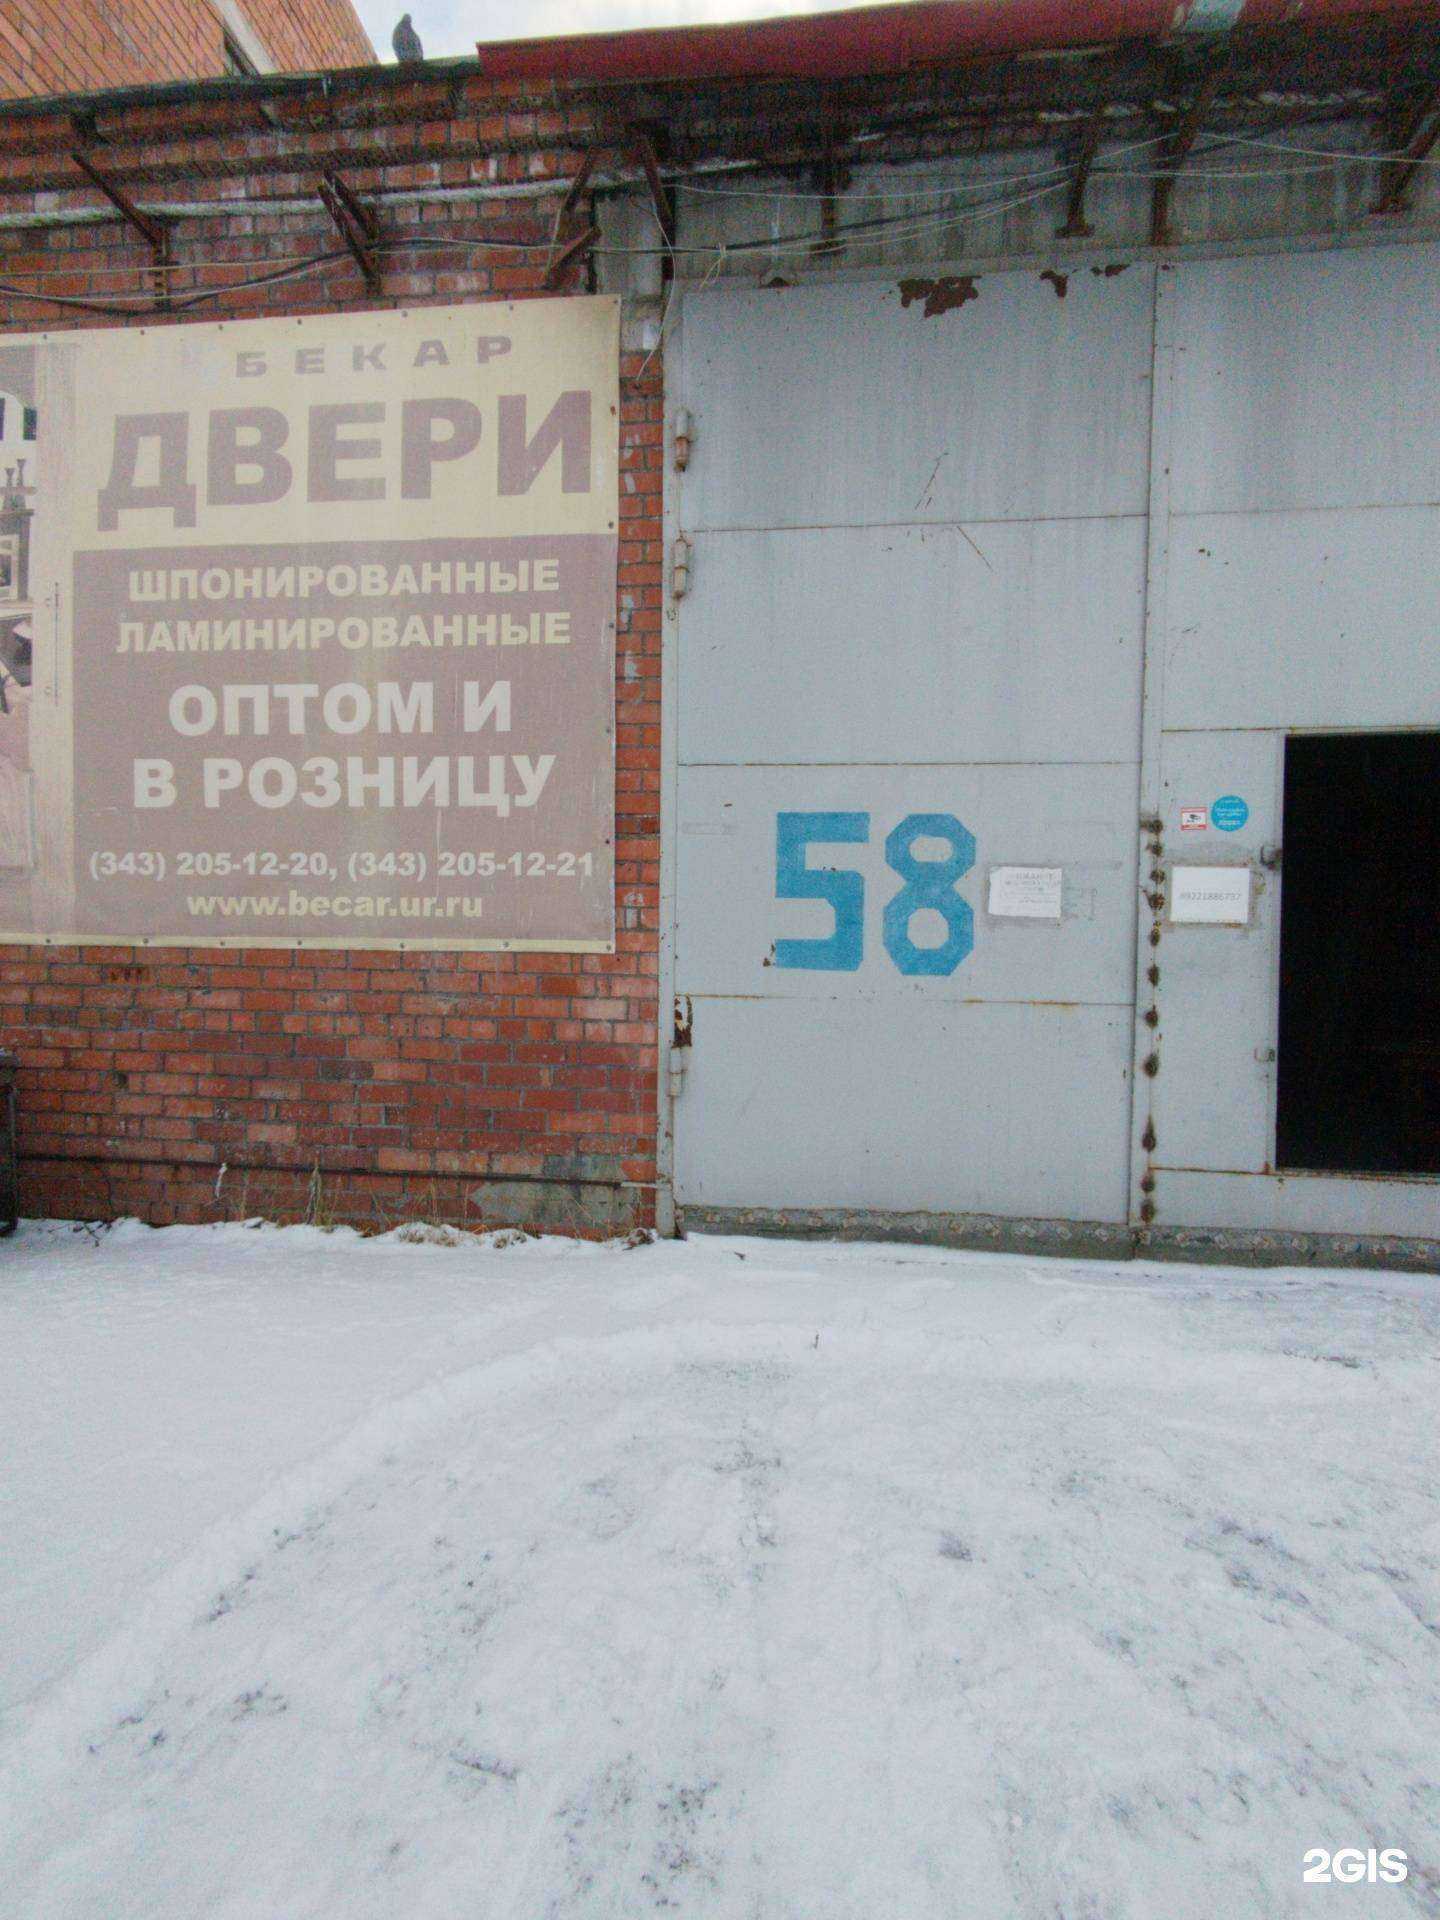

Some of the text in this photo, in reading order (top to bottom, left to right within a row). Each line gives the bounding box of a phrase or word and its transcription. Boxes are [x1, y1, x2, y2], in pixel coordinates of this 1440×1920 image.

[235, 335, 513, 378] БЕКАР
[97, 390, 593, 532] ДВЕРИ
[128, 558, 561, 603] ШПОНИРОВАННЫЕ
[116, 611, 572, 654] ЛАМИНИРОВАННЫЕ
[168, 679, 512, 737] ОПТОМ И
[133, 754, 557, 818] В РОЗНИЦУ
[89, 851, 593, 882] (343) 205-12-20, (343) 205-12-21
[187, 889, 483, 917] www.becar.ur.ru
[774, 811, 977, 976] 58
